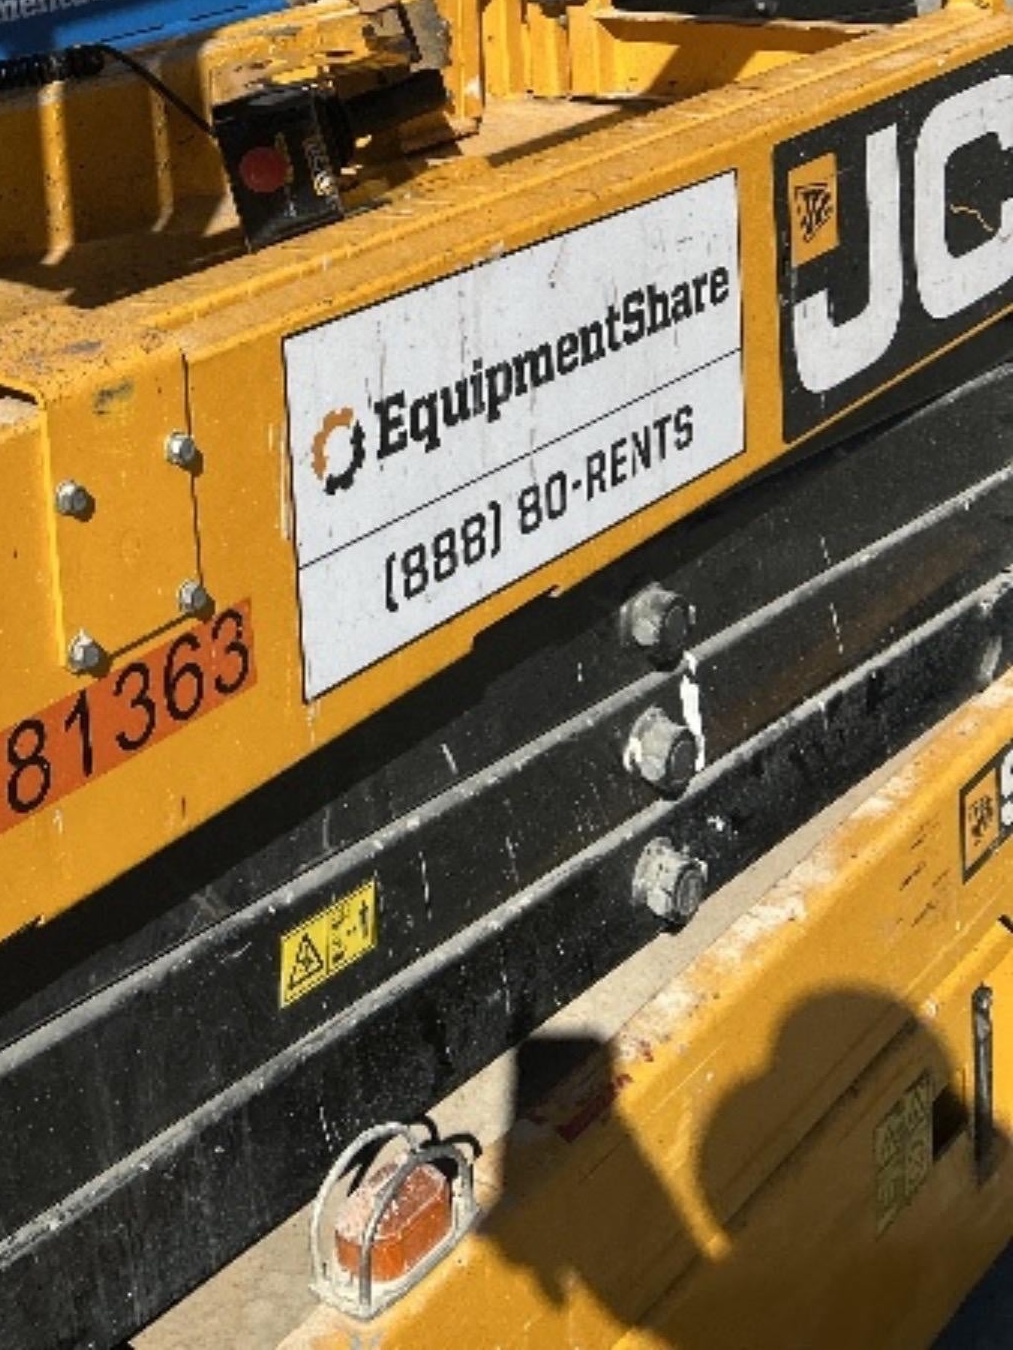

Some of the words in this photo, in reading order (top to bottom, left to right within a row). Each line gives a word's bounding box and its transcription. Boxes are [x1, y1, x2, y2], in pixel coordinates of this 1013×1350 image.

[793, 73, 1013, 394] JC
[376, 266, 730, 458] EquipmentShare
[385, 501, 503, 612] (888)
[519, 405, 694, 536] 80-RENTS
